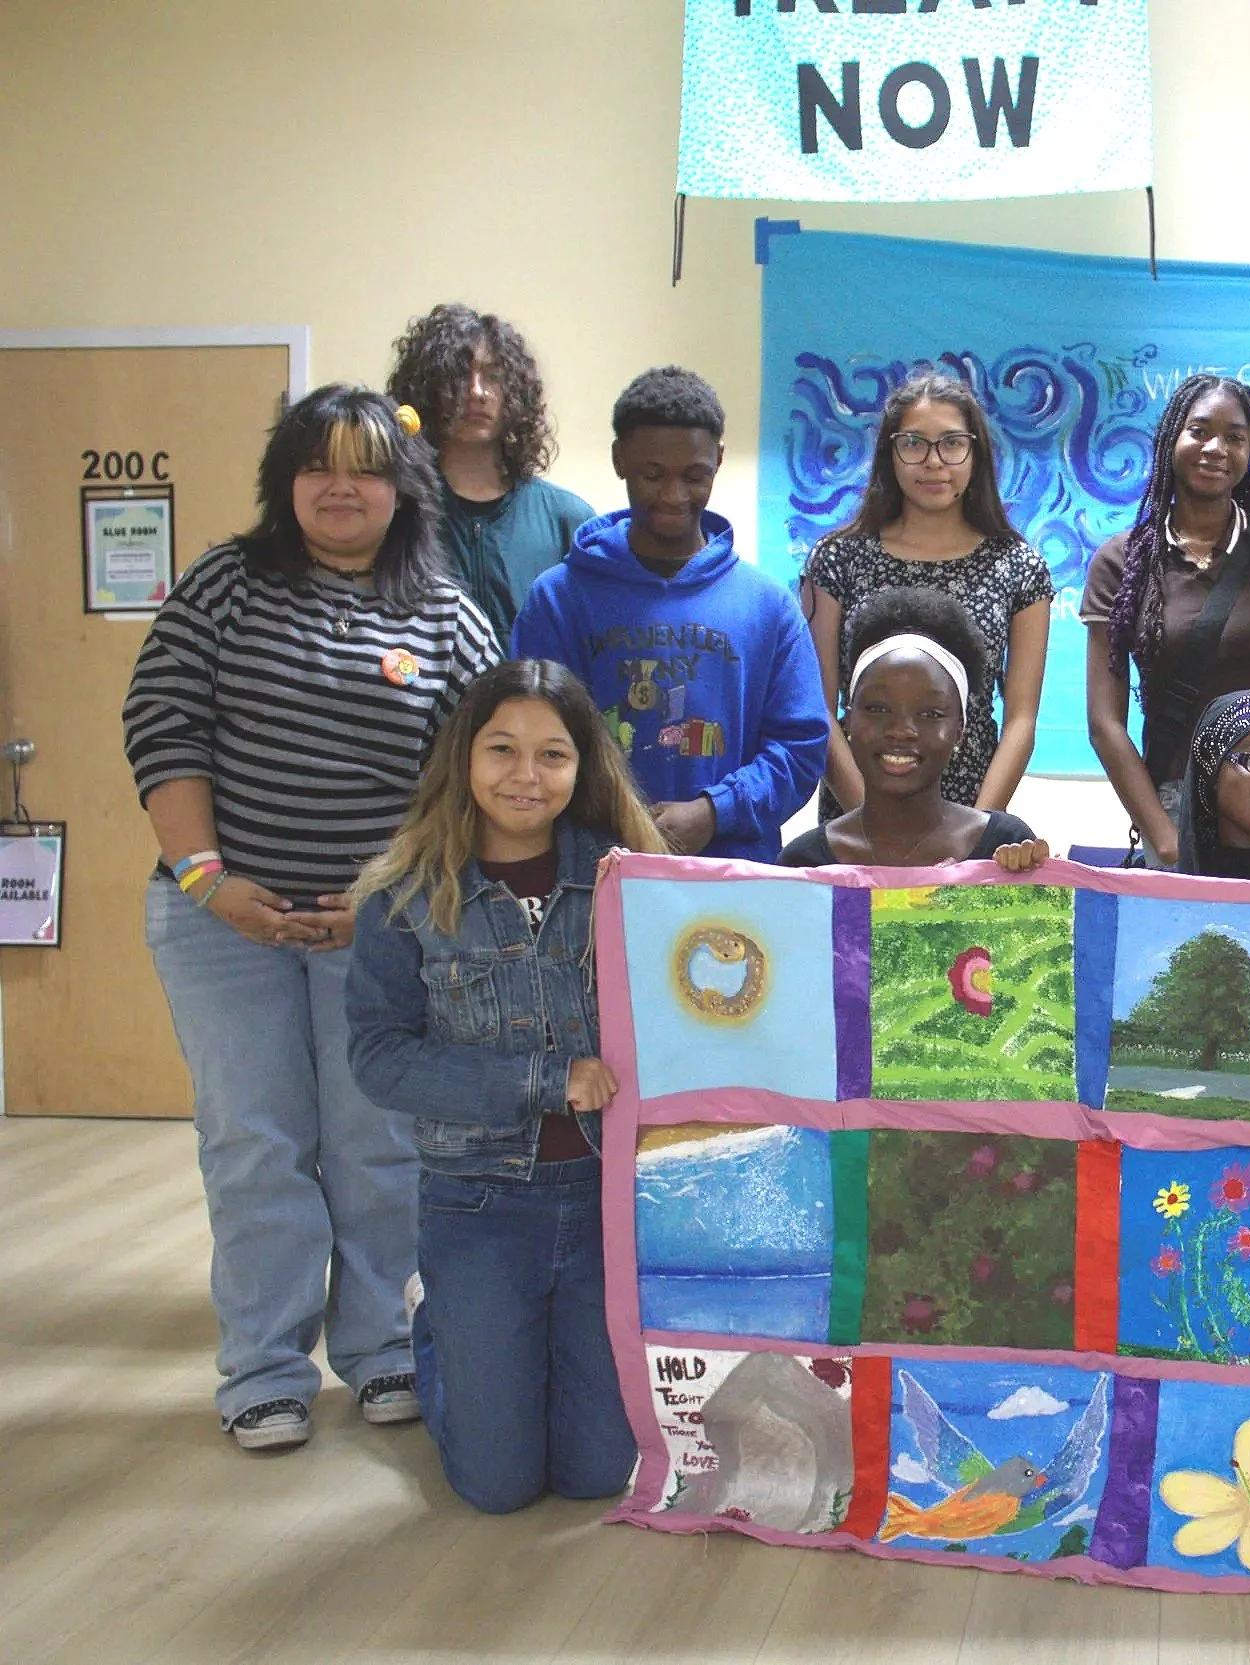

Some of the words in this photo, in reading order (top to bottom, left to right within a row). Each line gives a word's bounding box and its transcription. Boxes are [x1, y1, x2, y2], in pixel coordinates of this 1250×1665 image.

[797, 57, 1040, 154] NOW
[0, 889, 49, 901] AILABLE
[656, 1355, 706, 1384] HOLD
[655, 1387, 705, 1406] TIGHT
[672, 1411, 704, 1425] TO
[682, 1452, 721, 1471] LOVE
